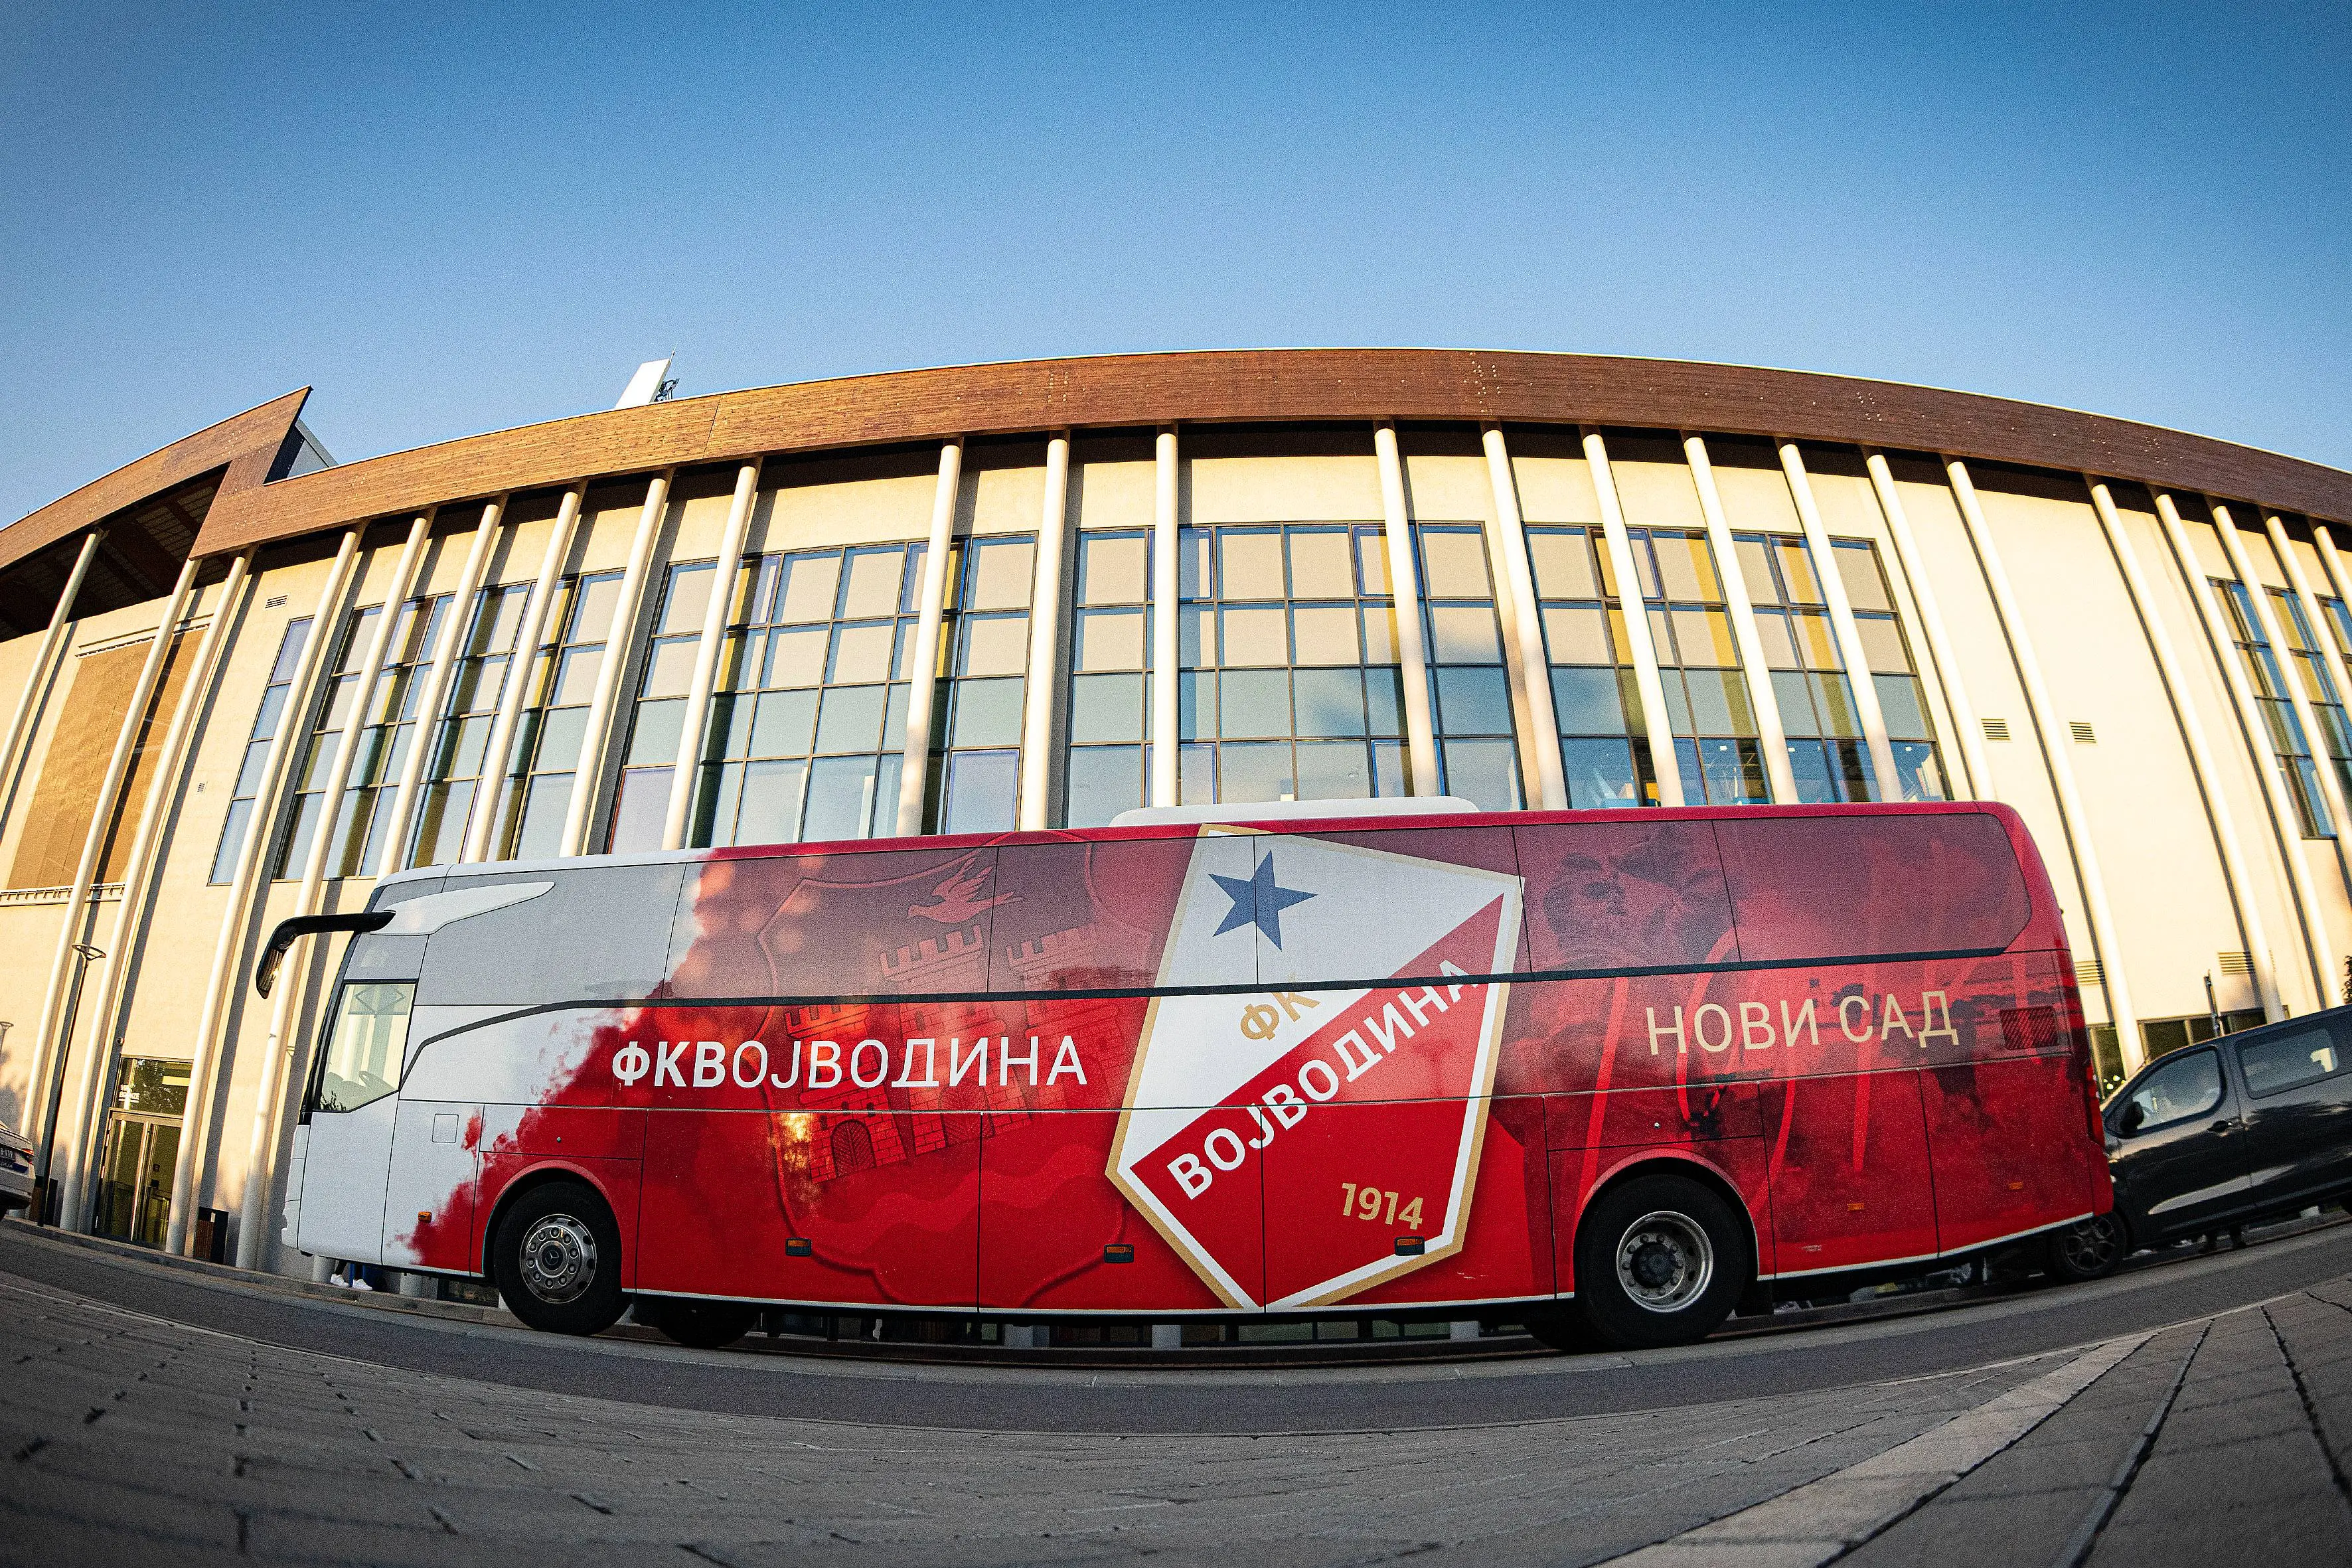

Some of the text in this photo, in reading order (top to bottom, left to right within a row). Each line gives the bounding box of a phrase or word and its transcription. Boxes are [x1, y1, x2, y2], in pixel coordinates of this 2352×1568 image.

[1646, 990, 1959, 1056] НОВИ САД
[1167, 959, 1479, 1200] ВОЈВОДИНА
[1342, 1182, 1423, 1230] 1914
